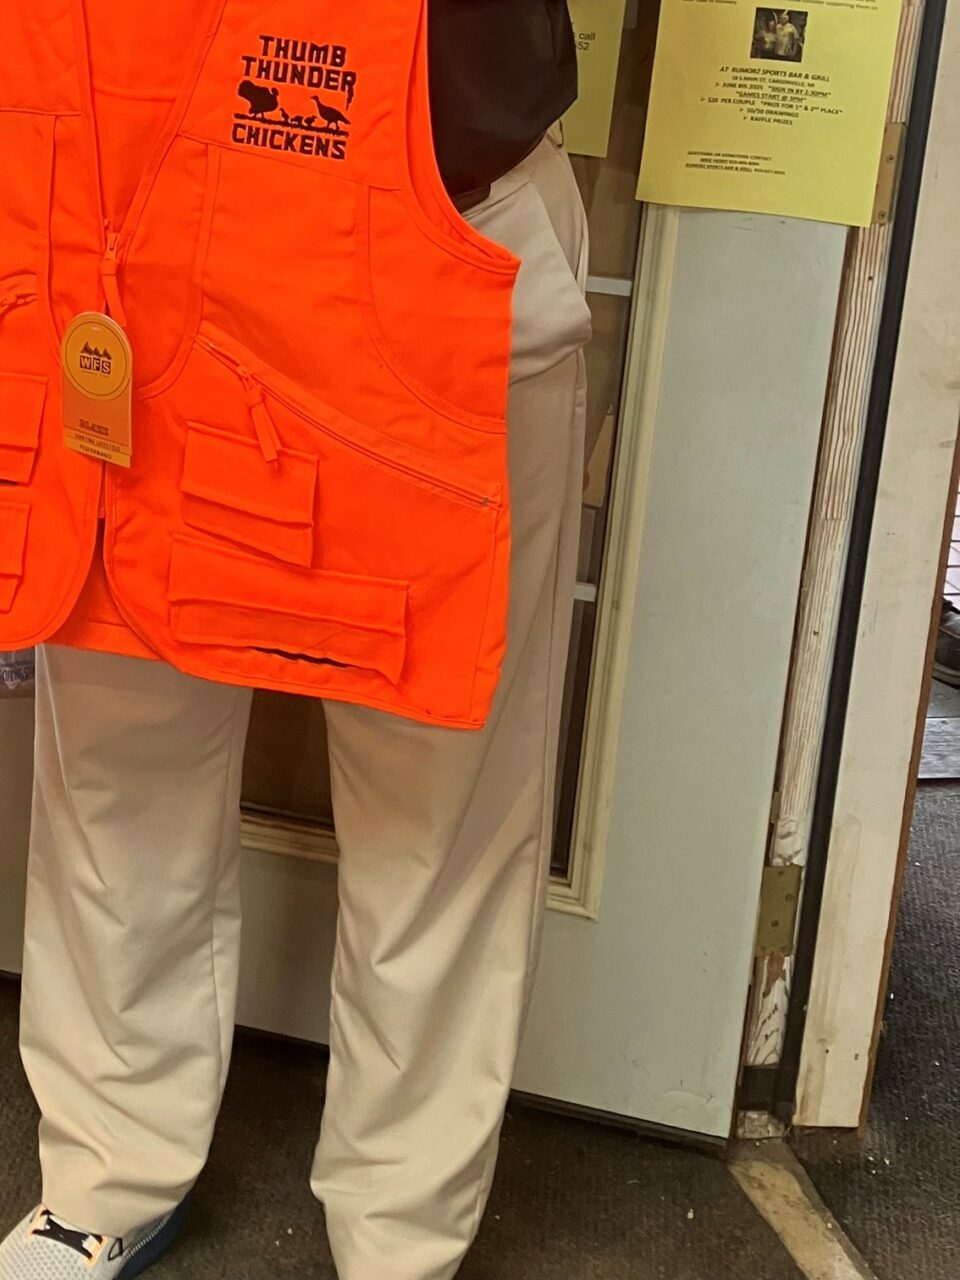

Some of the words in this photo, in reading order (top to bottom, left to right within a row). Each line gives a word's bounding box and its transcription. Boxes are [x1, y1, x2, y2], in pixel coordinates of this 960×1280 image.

[258, 34, 347, 68] THUMB
[241, 55, 357, 111] THUNDER
[231, 122, 347, 160] CHICKENS
[80, 355, 112, 375] WFS
